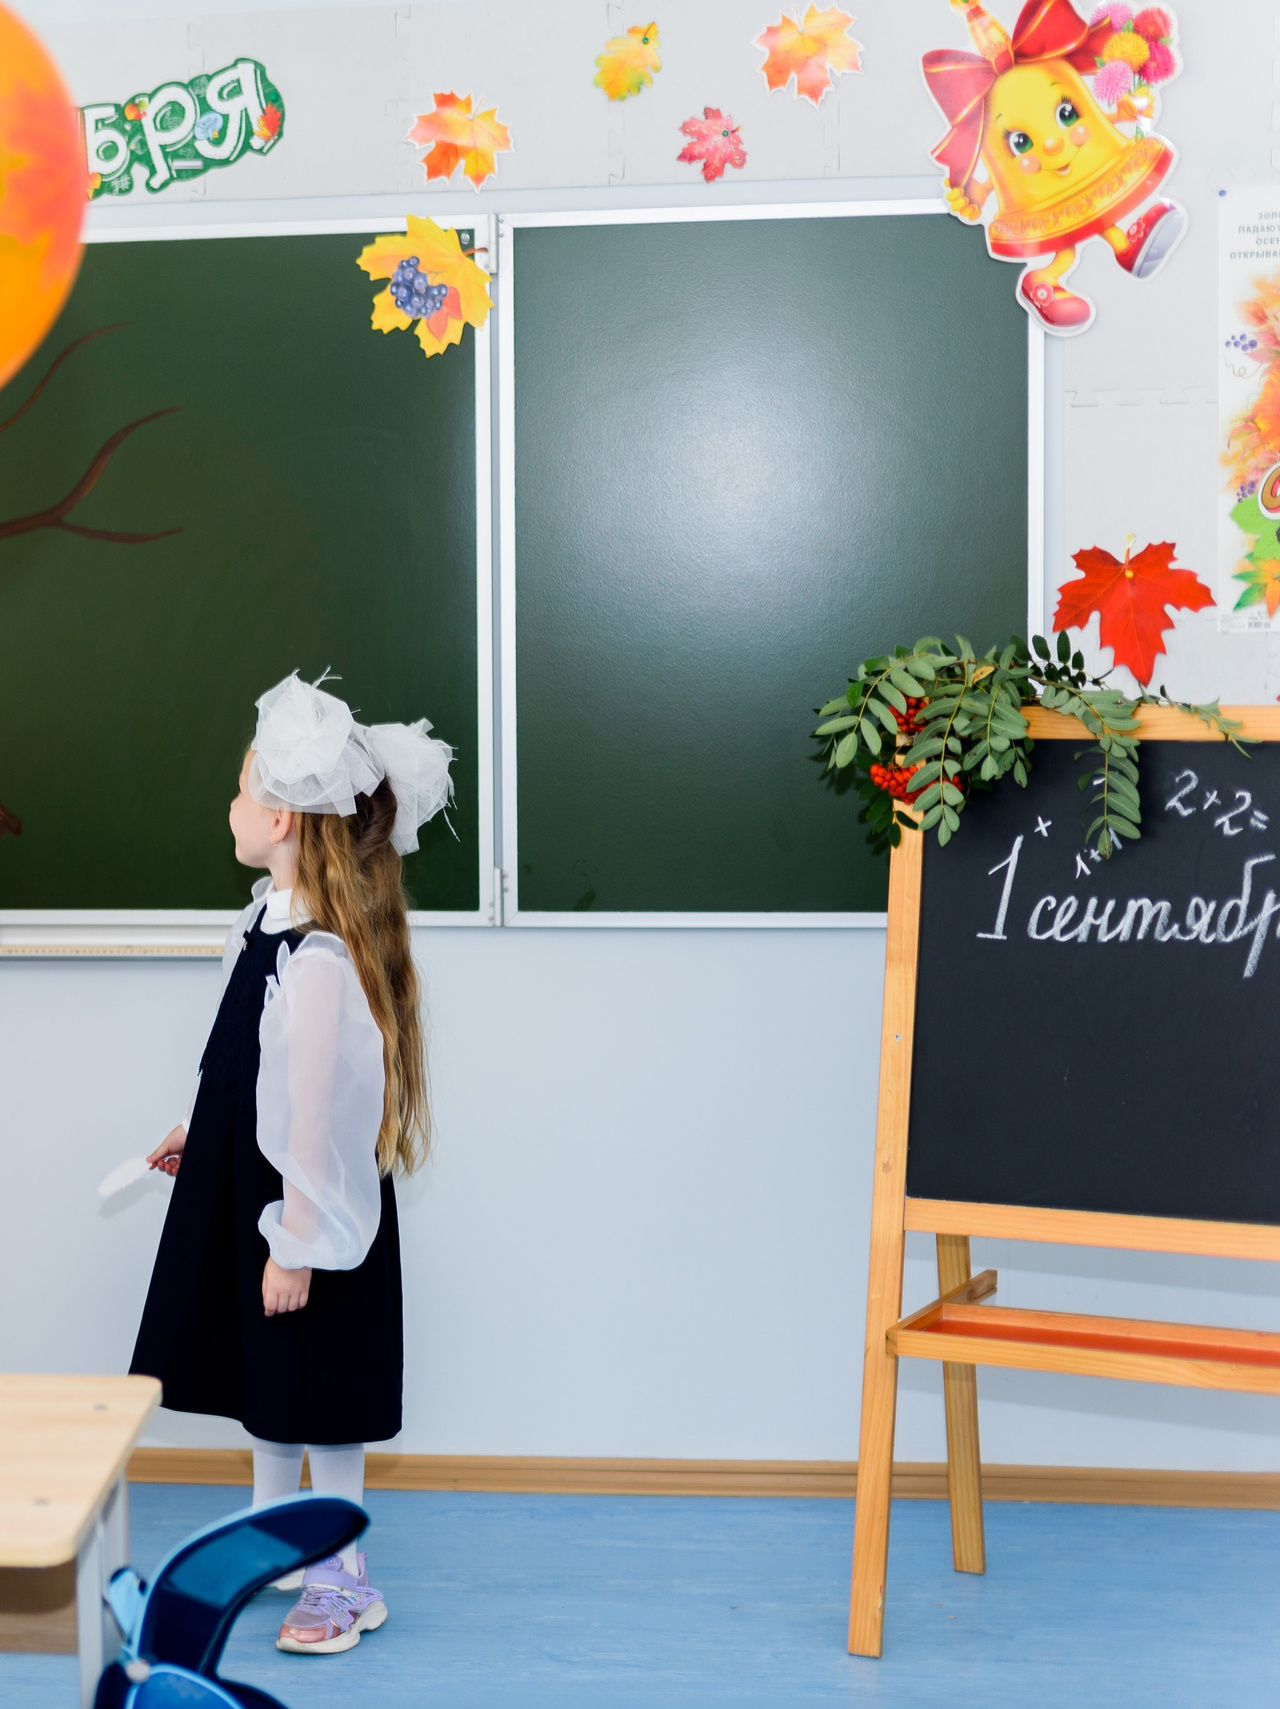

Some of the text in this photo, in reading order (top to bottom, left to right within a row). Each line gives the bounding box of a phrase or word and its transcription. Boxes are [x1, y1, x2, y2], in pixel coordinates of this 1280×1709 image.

[1258, 211, 1280, 220] ЗОЛ
[1230, 250, 1280, 260] ОТКРЫВА
[976, 835, 1024, 940] 1
